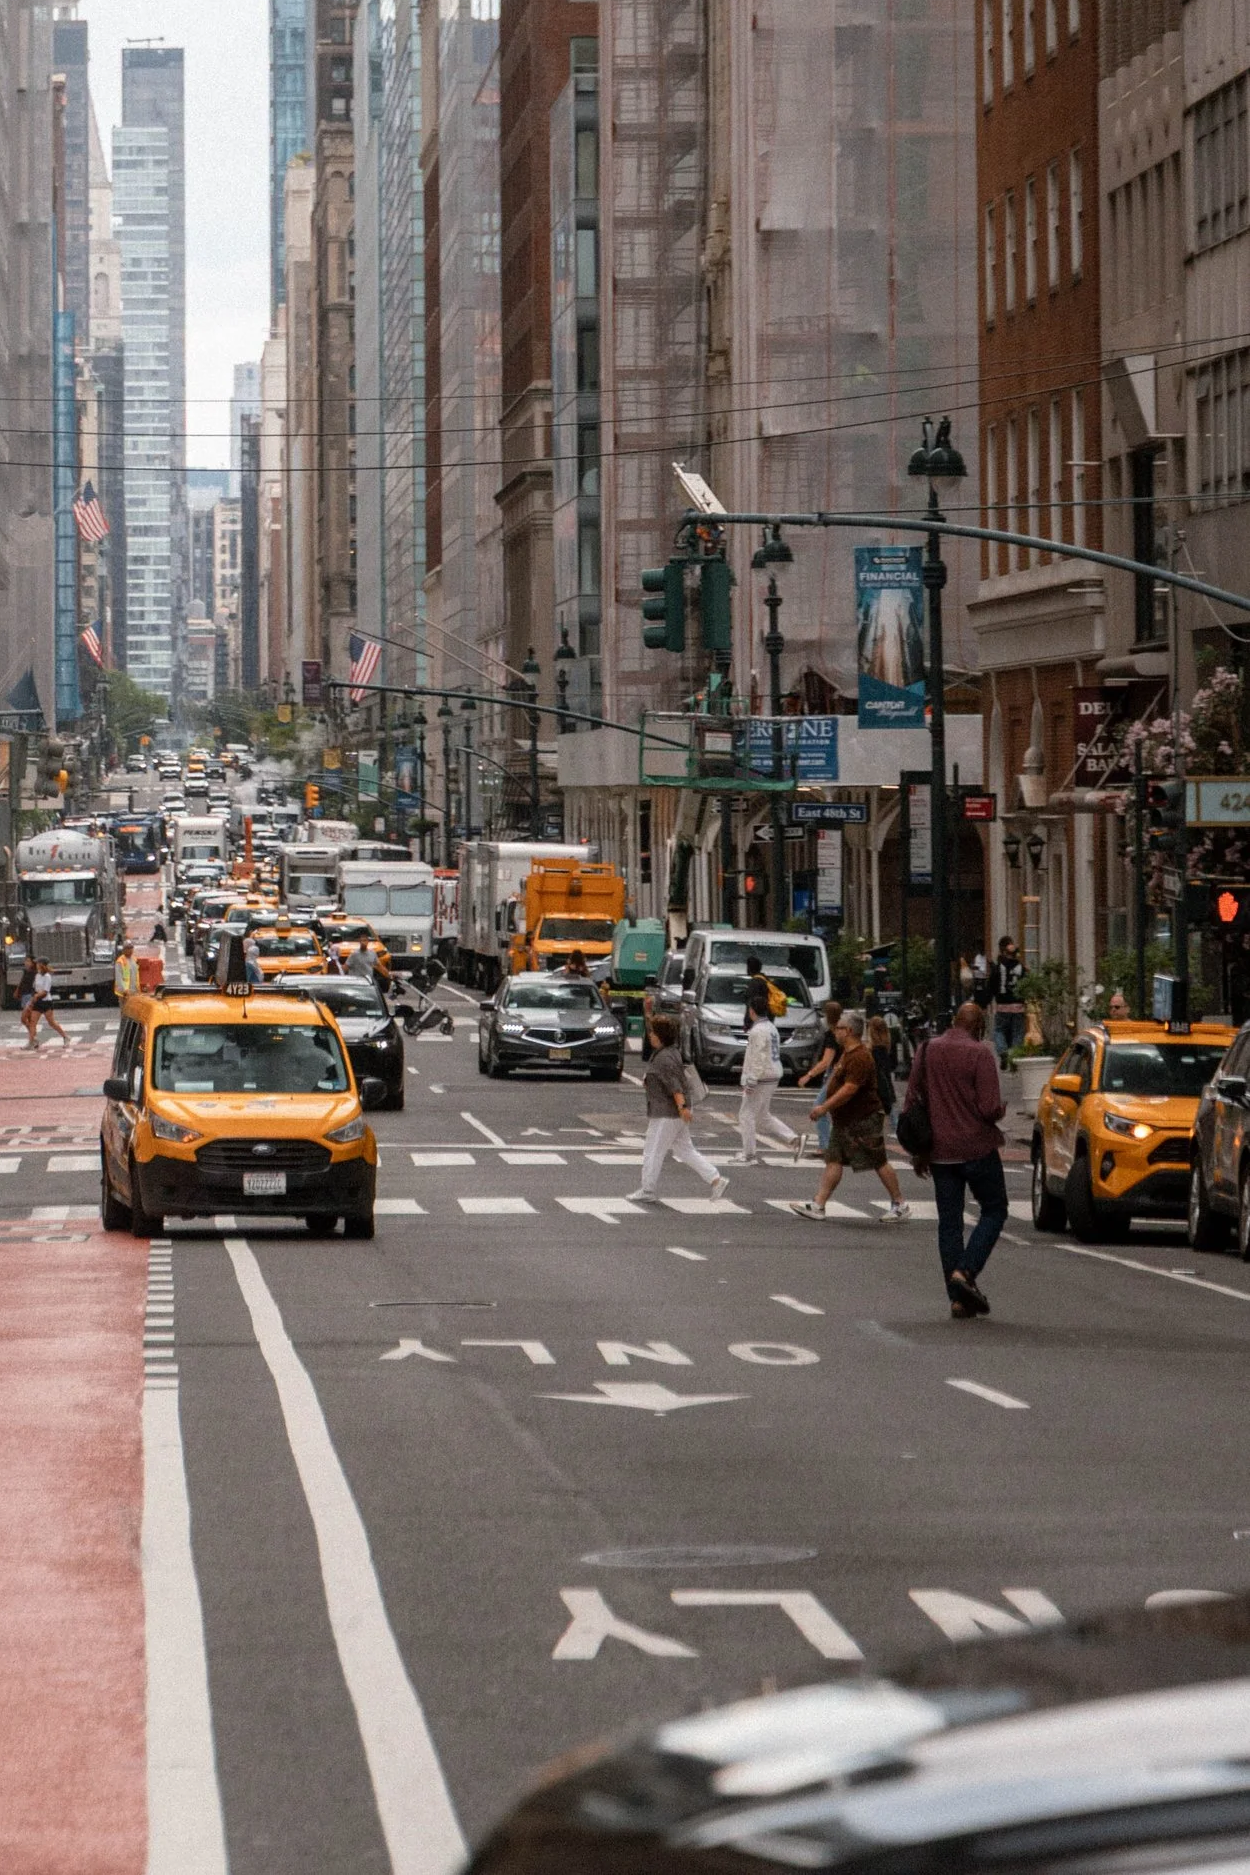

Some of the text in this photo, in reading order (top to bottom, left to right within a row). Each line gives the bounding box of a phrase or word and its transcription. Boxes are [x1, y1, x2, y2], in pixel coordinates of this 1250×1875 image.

[860, 572, 919, 581] FINANCIAL
[797, 807, 861, 819] East 48th St
[226, 983, 250, 995] 4Y23
[379, 1338, 821, 1366] ONLY
